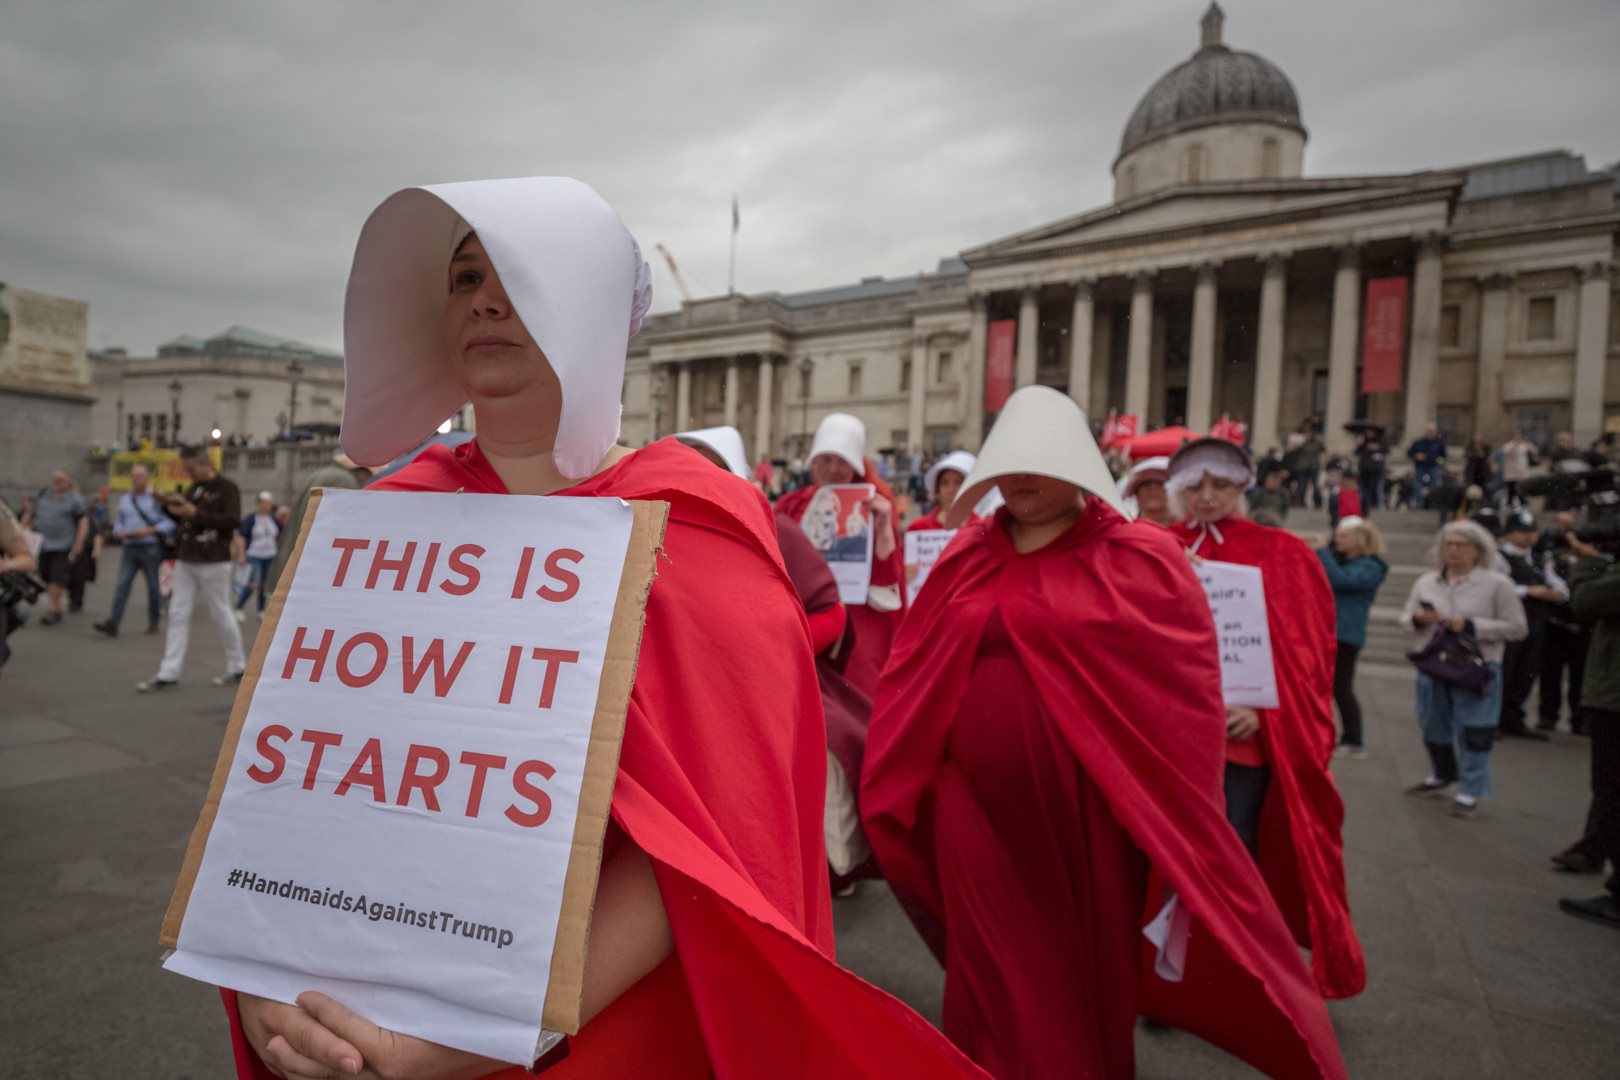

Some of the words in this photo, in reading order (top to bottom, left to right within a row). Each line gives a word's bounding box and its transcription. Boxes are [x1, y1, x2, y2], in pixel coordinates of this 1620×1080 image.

[332, 538, 486, 596] THIS
[511, 546, 585, 602] IS
[1206, 588, 1246, 600] aid's
[281, 626, 476, 698] HOW
[498, 645, 580, 709] IT
[246, 724, 557, 828] STARTS
[227, 868, 514, 949] #HandmaidsAgainstTrump
